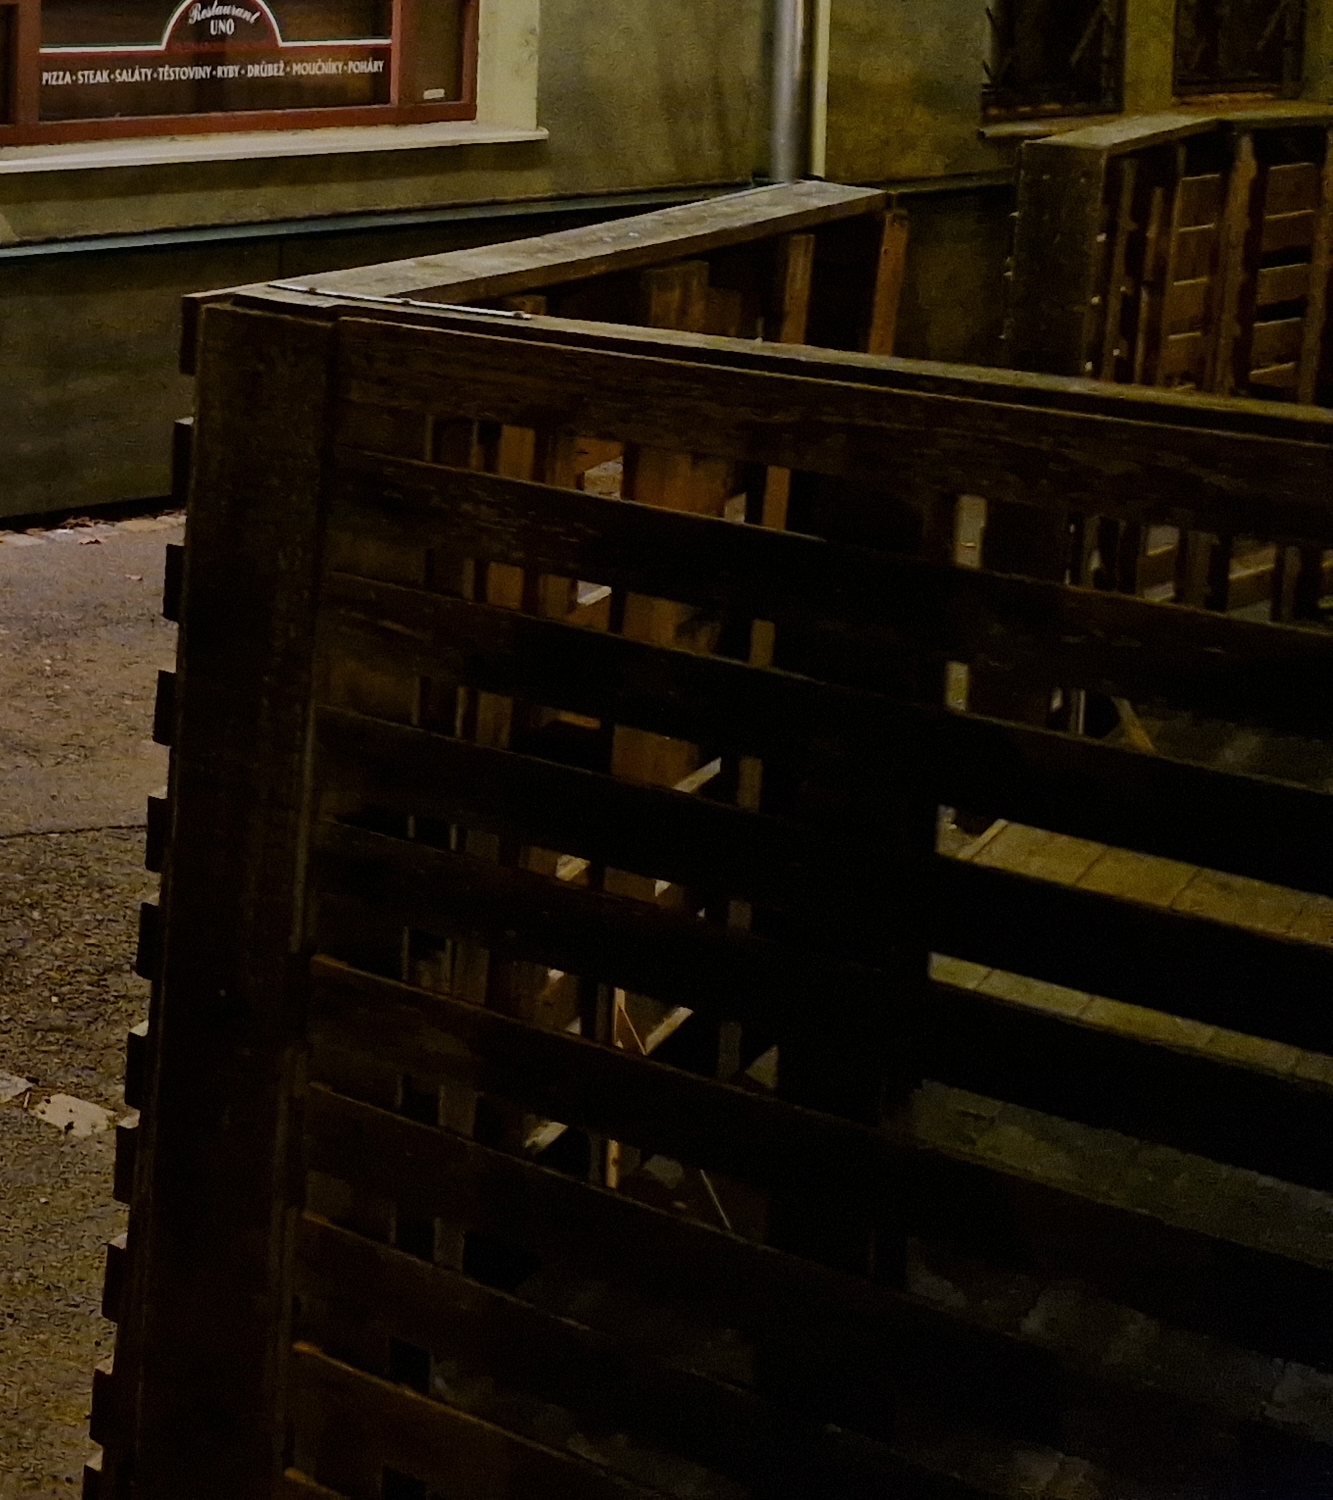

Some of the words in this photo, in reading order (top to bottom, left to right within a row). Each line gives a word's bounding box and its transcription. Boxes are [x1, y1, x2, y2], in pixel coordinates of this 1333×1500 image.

[210, 18, 235, 36] UNO
[42, 70, 72, 85] PIZZA
[77, 69, 110, 84] STEAK
[115, 65, 153, 83] SALÁTY
[216, 65, 241, 79] RYBY
[347, 56, 385, 74] POHÁRY
